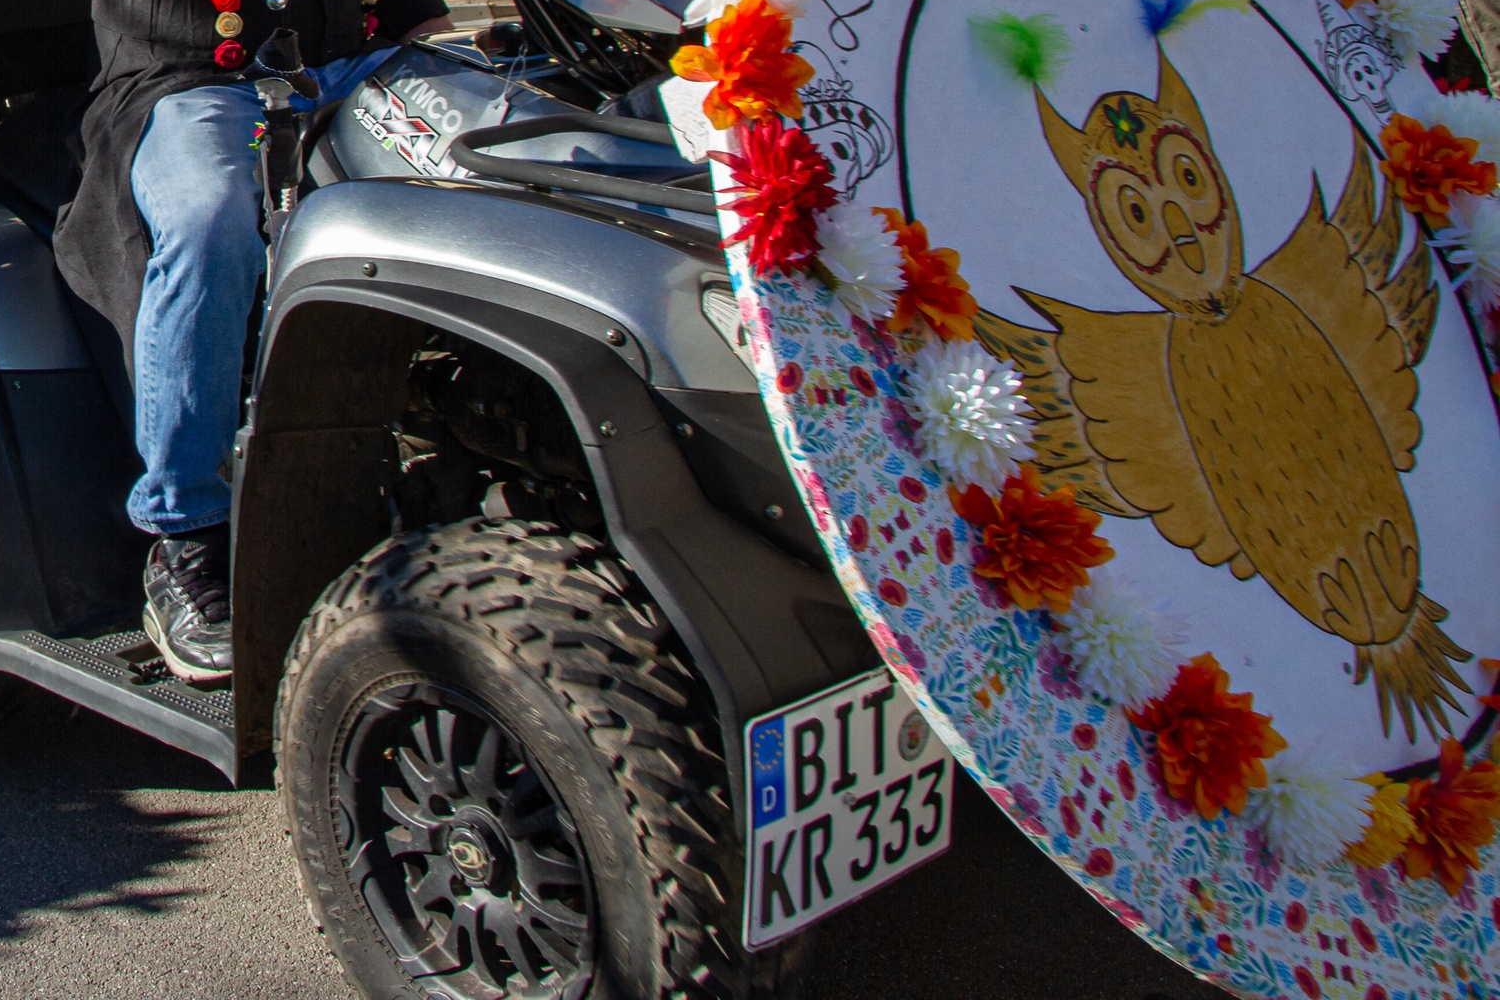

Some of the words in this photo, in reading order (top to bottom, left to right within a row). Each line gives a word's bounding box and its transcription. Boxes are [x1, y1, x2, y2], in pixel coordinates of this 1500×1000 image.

[391, 63, 464, 134] KYMCO
[792, 684, 895, 813] BIT
[758, 813, 834, 928] KR
[848, 758, 946, 882] 333
[761, 785, 777, 813] D
